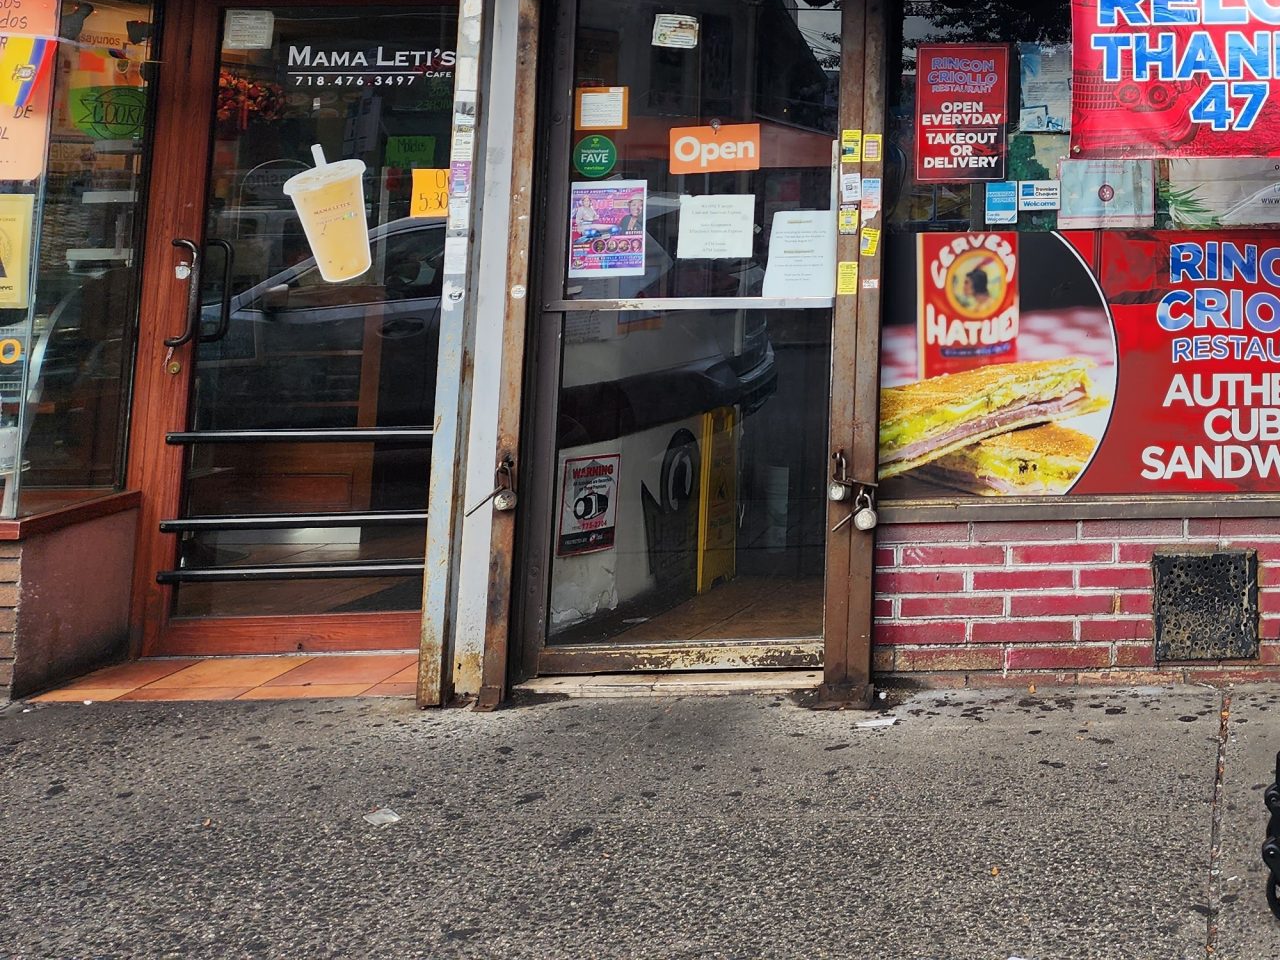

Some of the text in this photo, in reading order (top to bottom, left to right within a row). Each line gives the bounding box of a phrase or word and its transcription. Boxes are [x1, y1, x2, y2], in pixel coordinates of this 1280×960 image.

[287, 45, 457, 67] MAMA LETI'S
[931, 56, 995, 72] RINCON
[295, 76, 416, 86] 718.476.3497
[426, 70, 452, 79] CAFE
[928, 70, 998, 86] CRIOLLO
[932, 84, 993, 94] RESTAURANT
[13, 104, 34, 119] DE
[941, 101, 984, 113] OPEN
[1188, 81, 1269, 131] 47
[922, 113, 1002, 126] EVERYDAY
[925, 132, 998, 144] TAKEOUT
[673, 135, 755, 167] Open
[949, 144, 973, 156] OR
[580, 153, 609, 163] FAVE
[923, 156, 999, 169] DELIVERY
[572, 464, 614, 480] WARNING
